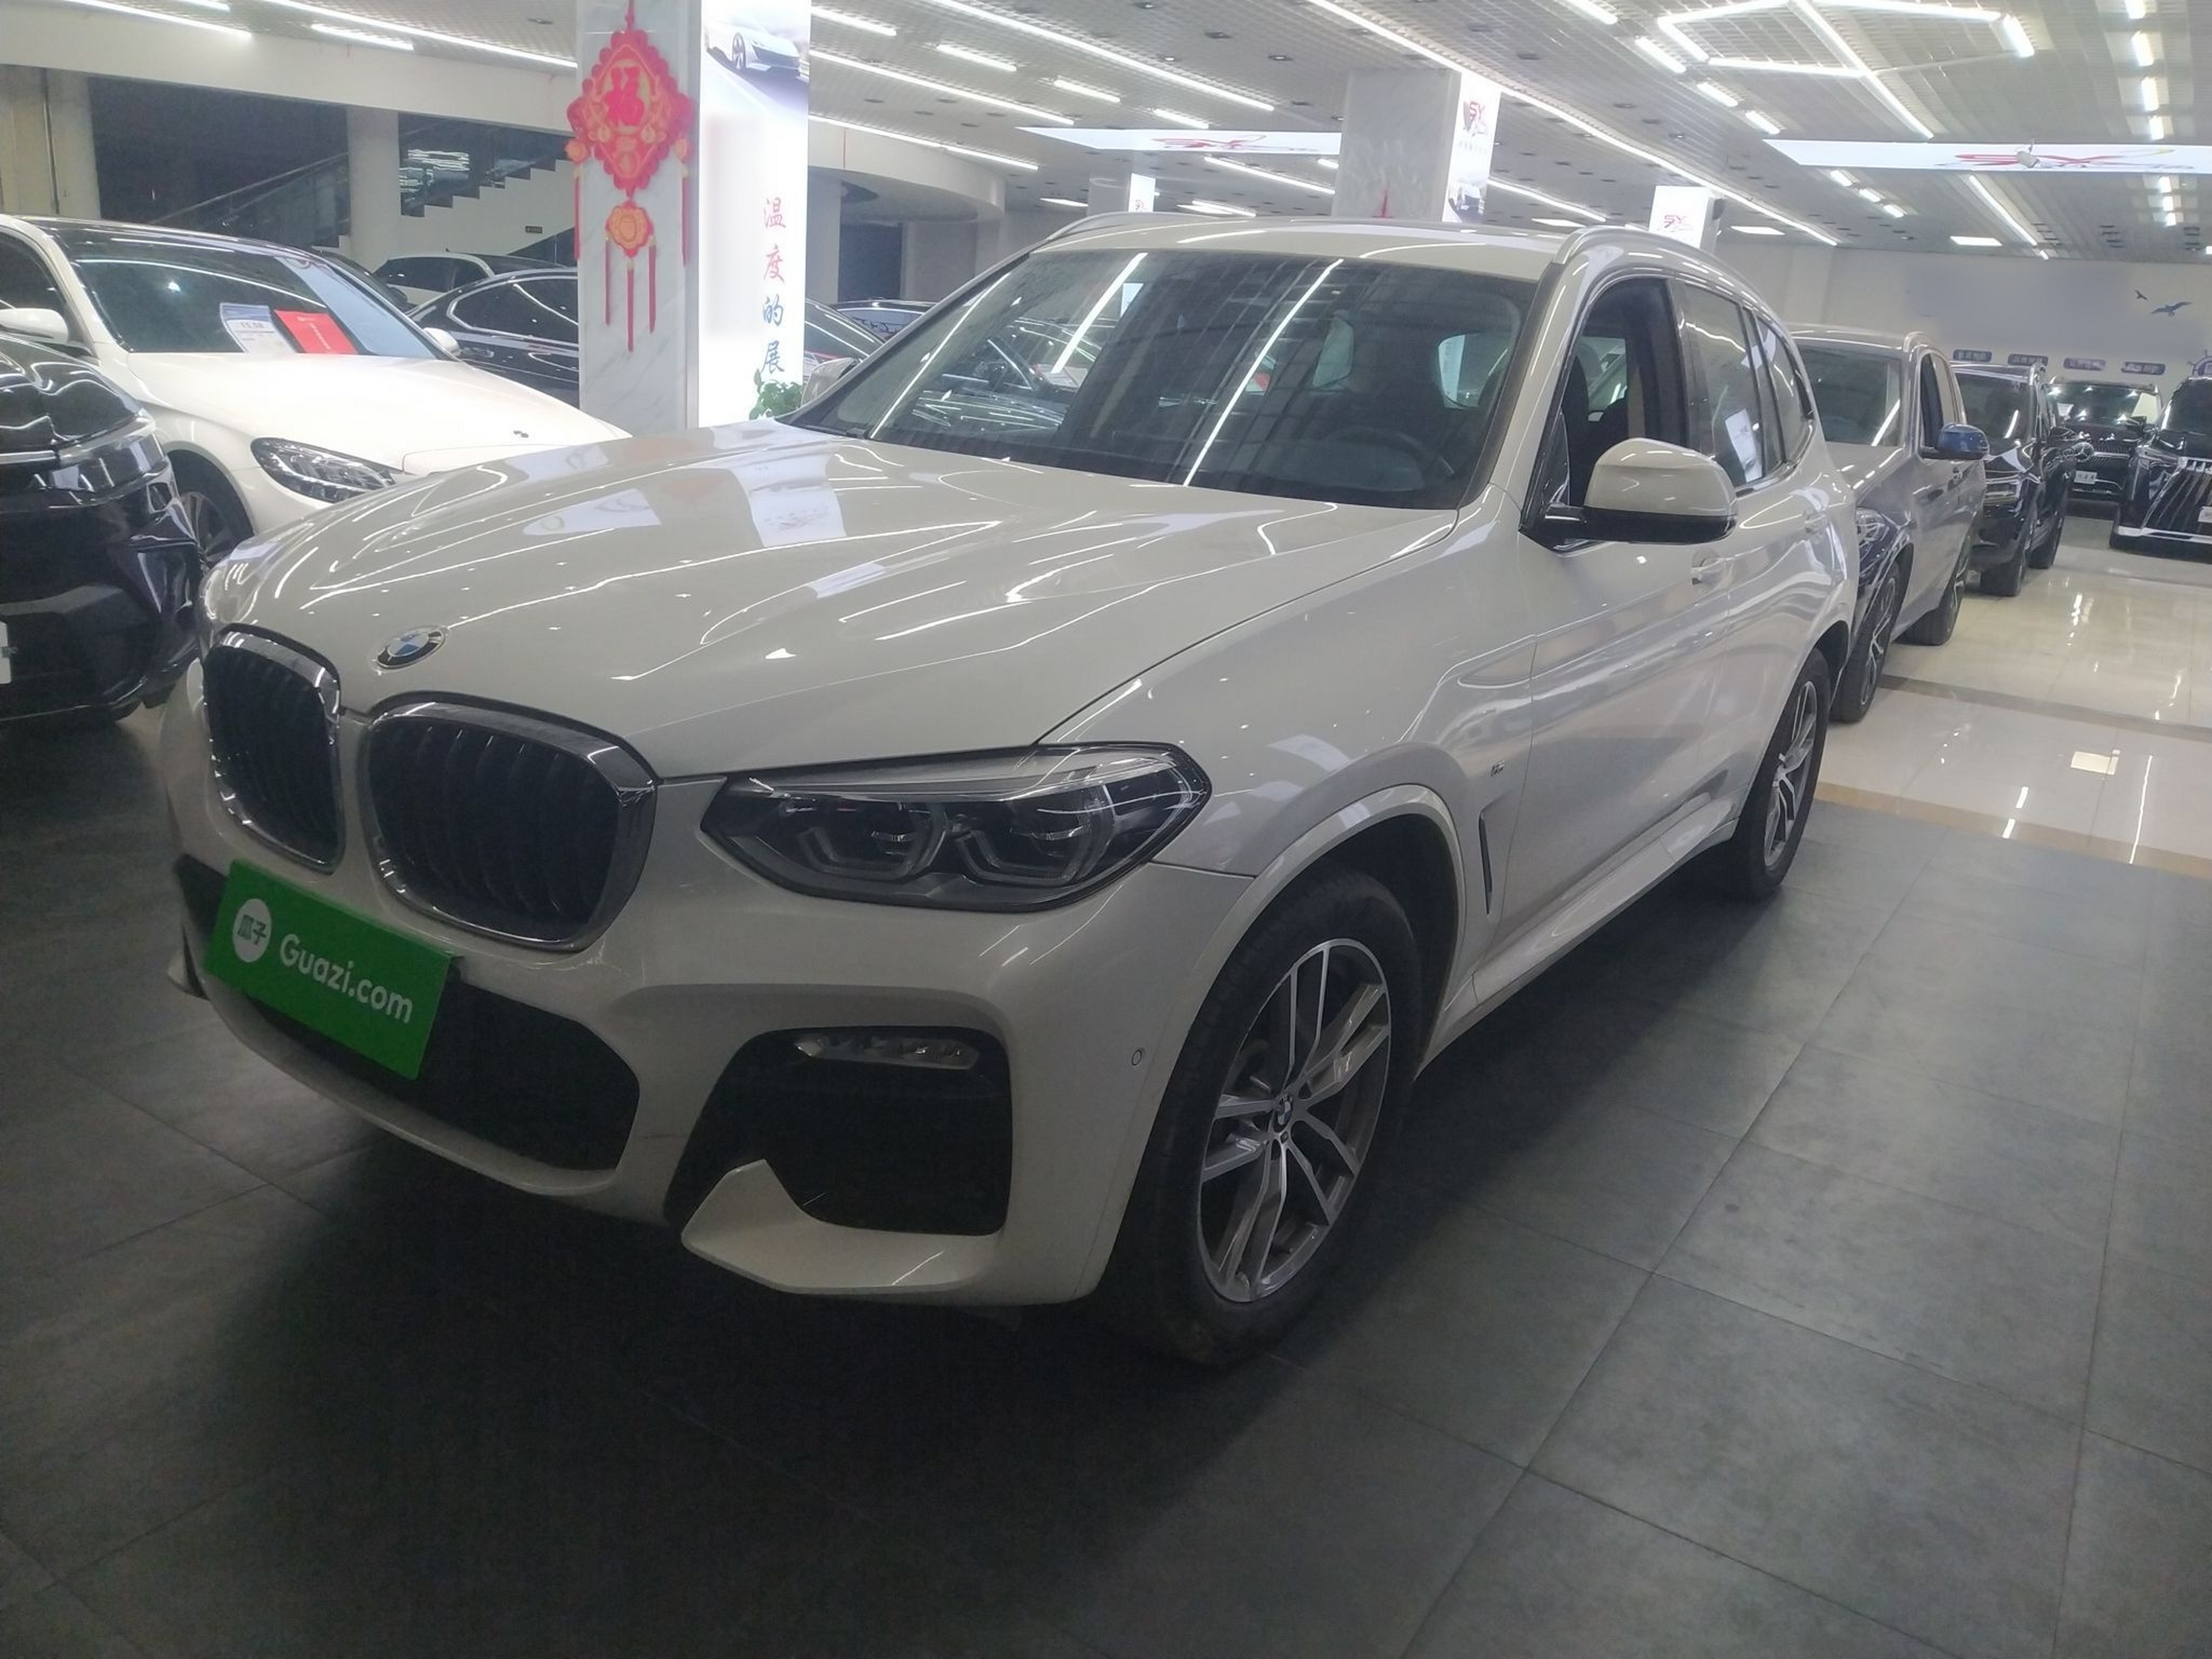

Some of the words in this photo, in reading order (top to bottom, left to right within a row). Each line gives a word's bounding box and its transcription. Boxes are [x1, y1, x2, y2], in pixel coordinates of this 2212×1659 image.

[761, 197, 787, 374] 温度的展
[280, 933, 413, 1024] Guazi.com
